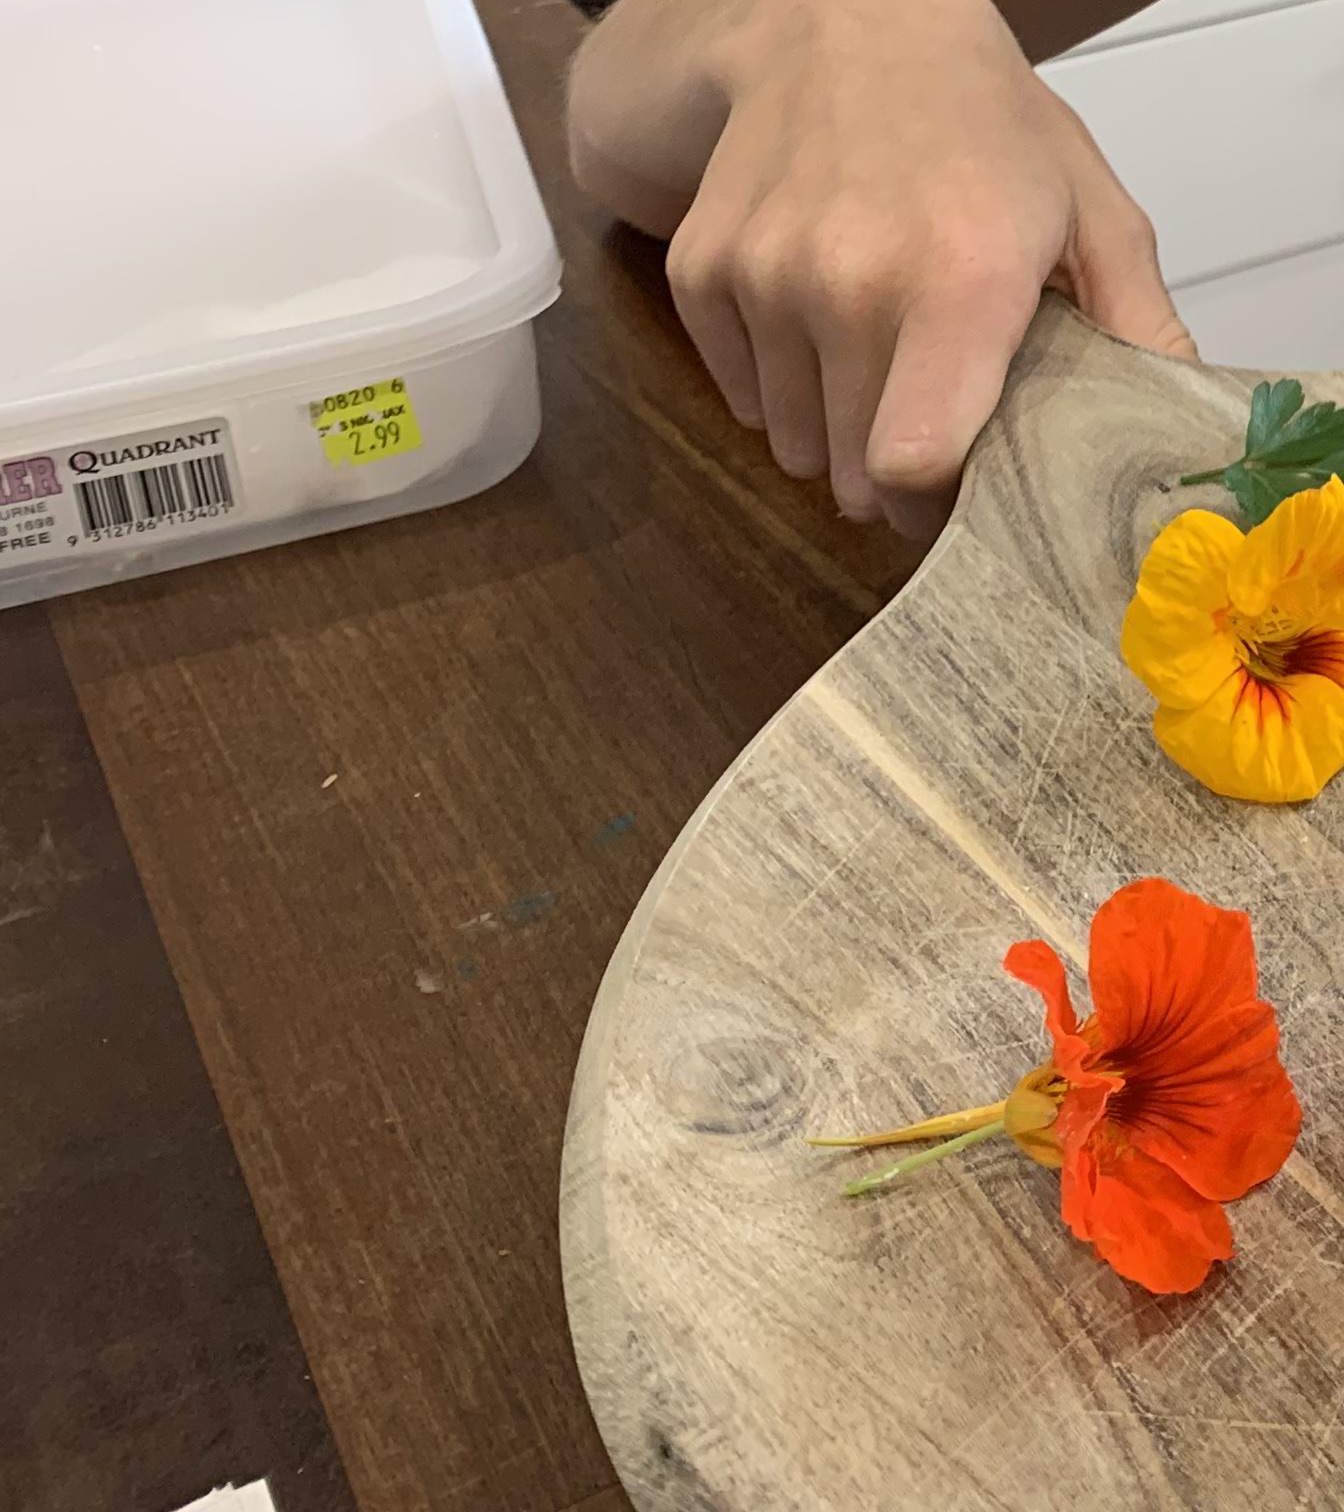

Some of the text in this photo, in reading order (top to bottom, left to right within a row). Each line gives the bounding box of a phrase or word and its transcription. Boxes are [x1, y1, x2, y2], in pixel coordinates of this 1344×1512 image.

[323, 378, 404, 413] 0820 6
[68, 429, 221, 475] QUADRANT
[348, 421, 400, 456] 2.99
[67, 504, 231, 548] 9 312786 113401
